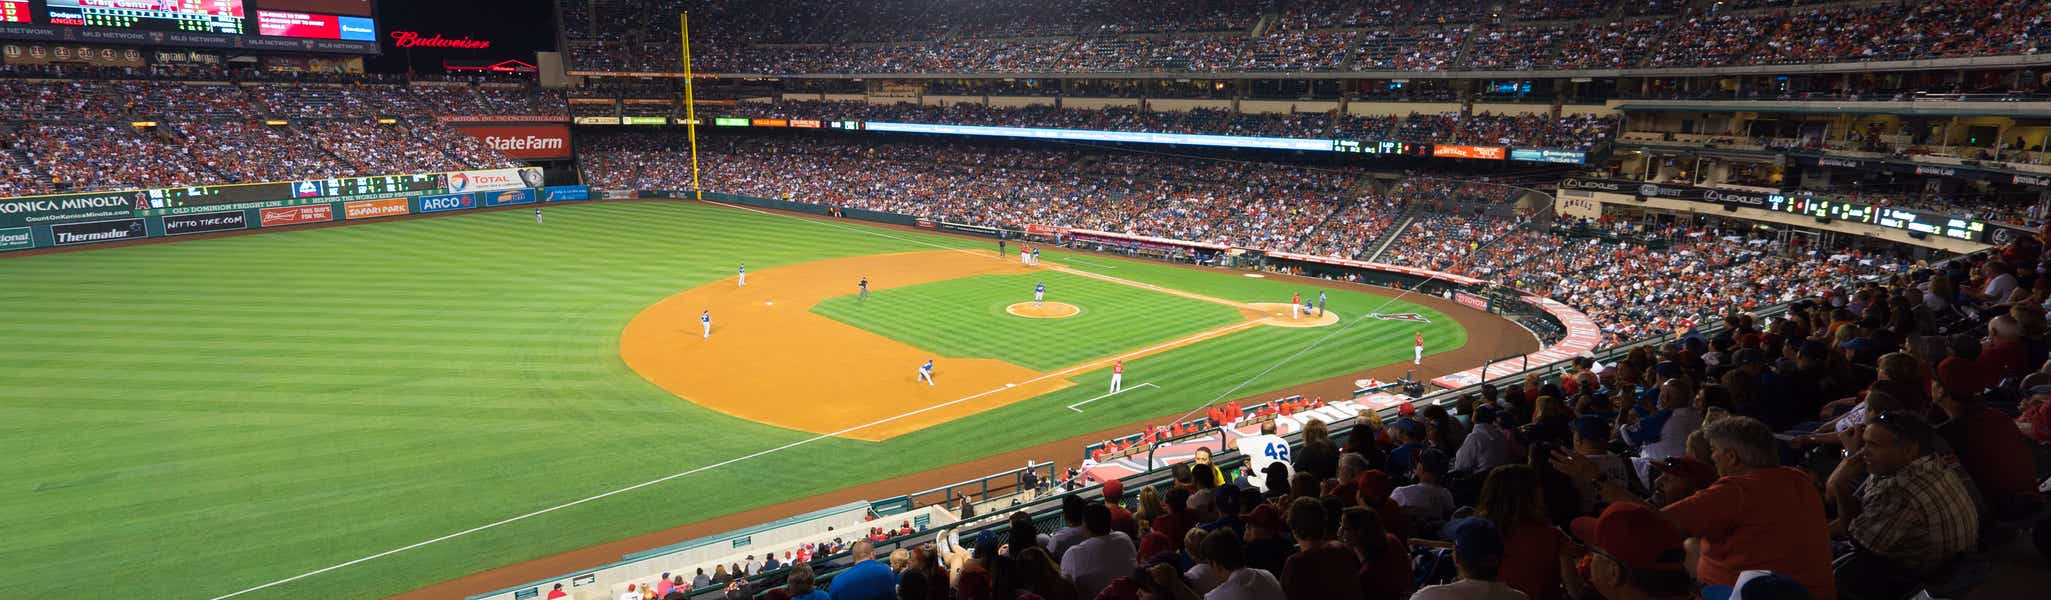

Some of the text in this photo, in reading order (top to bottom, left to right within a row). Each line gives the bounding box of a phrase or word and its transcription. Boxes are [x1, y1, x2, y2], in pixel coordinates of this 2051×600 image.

[7, 28, 55, 36] NETWORK
[391, 31, 490, 49] Budweiser
[155, 51, 220, 65] Captain Morgan
[472, 175, 510, 184] TOTAL
[1579, 181, 1618, 191] LEXUS
[61, 196, 129, 211] MINOLTA
[353, 194, 377, 202] WORLD
[424, 197, 460, 210] ARCO
[1719, 193, 1762, 205] LEXUS
[1768, 195, 1784, 204] LAD
[191, 204, 232, 213] DOMINION
[233, 202, 265, 210] FREIGHT
[349, 206, 381, 216] SAFARI
[382, 204, 407, 213] PARK
[1563, 199, 1593, 210] ANGELS
[26, 210, 130, 222] CountOnKonicaMinolta.com
[167, 216, 243, 230] NITTO TIRE.COM
[57, 228, 129, 243] Thermador
[1463, 294, 1487, 309] TOYOTA
[1265, 442, 1290, 462] 42
